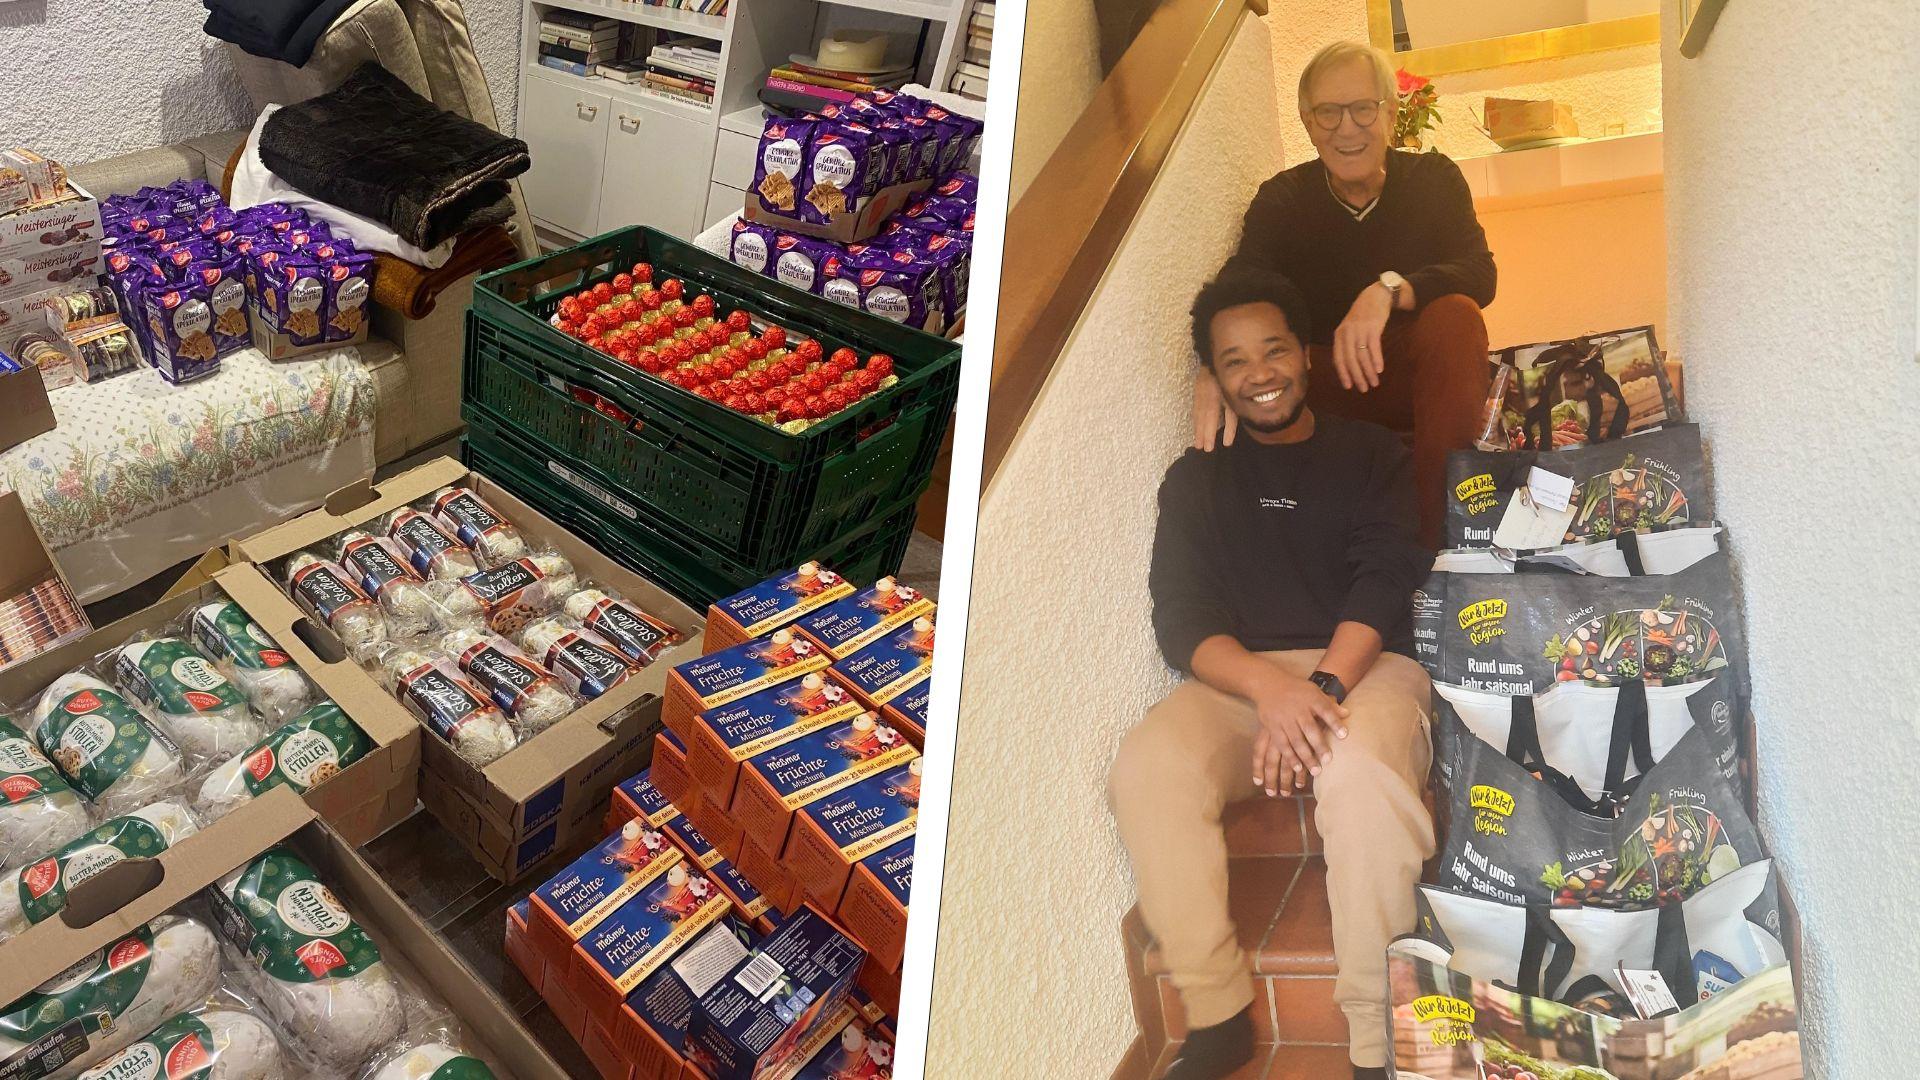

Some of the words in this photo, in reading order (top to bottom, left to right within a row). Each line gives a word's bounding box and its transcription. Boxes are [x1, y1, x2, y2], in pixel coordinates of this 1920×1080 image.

[766, 154, 798, 166] SPEKULATIUS
[816, 162, 852, 176] SPEKULATIUS
[822, 156, 846, 166] GEWÜRZ
[14, 213, 77, 234] Meistersinger
[24, 251, 82, 274] Meistersinger
[736, 247, 765, 261] SPEKULATIUS
[779, 266, 812, 281] SPEKULATIUS
[868, 302, 906, 312] SPEKULATIUS
[1644, 458, 1680, 482] Frühling
[1473, 478, 1479, 490] &
[460, 498, 496, 526] Stollen
[1468, 498, 1498, 516] Region
[414, 520, 450, 548] Stollen
[1464, 527, 1490, 540] Rund
[368, 546, 402, 576] Stollen
[316, 572, 352, 602] Stollen
[484, 571, 528, 597] Stollen
[730, 596, 756, 610] Meßmer
[738, 598, 780, 618] Früchte-
[1684, 597, 1714, 618] Frühling
[752, 608, 780, 622] Mischung
[812, 613, 839, 629] Meßmer
[1460, 611, 1475, 625] Wir
[1476, 605, 1481, 617] &
[1483, 602, 1503, 616] Jetzt
[1566, 606, 1594, 625] Winter
[610, 610, 656, 642] Stollen
[822, 615, 862, 638] Früchte-
[837, 626, 863, 641] Mischung
[1470, 627, 1506, 645] Region
[484, 654, 530, 684] Stollen
[576, 644, 624, 674] Stollen
[849, 656, 876, 673] Meßmer
[1468, 658, 1496, 673] Rund
[1499, 664, 1524, 675] ums
[186, 660, 218, 686] STOLLEN
[690, 662, 722, 677] Meßmer
[698, 666, 746, 687] Früchte-
[859, 659, 900, 683] Früchte-
[875, 670, 902, 686] Mischung
[584, 675, 606, 692] EDEKA
[711, 677, 743, 692] Mischung
[1461, 676, 1484, 690] Jahr
[1485, 679, 1533, 694] saisonal
[428, 676, 472, 712] Stollen
[717, 709, 750, 725] Meßmer
[726, 714, 776, 738] Früchte-
[69, 725, 100, 754] STOLLEN
[740, 726, 774, 741] Mischung
[288, 741, 329, 775] STOLLEN
[735, 749, 745, 757] Für
[746, 744, 760, 752] deine
[767, 753, 800, 771] Meßmer
[776, 758, 828, 784] Früchte-
[792, 771, 826, 789] Mischung
[788, 798, 798, 806] Für
[799, 792, 814, 801] deine
[1485, 789, 1490, 804] &
[1491, 790, 1511, 811] Jetzt
[1669, 787, 1706, 805] Frühling
[822, 801, 857, 820] Meßmer
[832, 806, 885, 835] Früchte-
[848, 820, 885, 839] Mischung
[1475, 816, 1507, 836] Region
[846, 849, 857, 858] Für
[857, 842, 873, 853] deine
[1567, 848, 1605, 862] Winter
[68, 854, 119, 883] BUTTER-MANDEL-
[1464, 840, 1489, 872] Rund
[1489, 864, 1515, 887] ums
[551, 875, 580, 899] Meßmer
[1451, 856, 1471, 882] Jahr
[1472, 876, 1526, 905] saisonal
[561, 876, 605, 912] Früchte-
[573, 926, 583, 934] Für
[584, 915, 597, 926] deine
[633, 873, 647, 886] Beutel
[660, 851, 678, 866] Genuss
[295, 888, 339, 929] STOLLEN
[576, 891, 605, 915] Mischung
[596, 925, 626, 950] Meßmer
[606, 926, 651, 964] Früchte-
[620, 978, 631, 988] Für
[630, 966, 644, 978] deine
[642, 942, 674, 966] Teemomente:
[680, 923, 697, 938] Beutel
[708, 899, 726, 913] Genuss
[622, 942, 651, 967] Mischung
[1414, 1000, 1435, 1018] Wir
[1437, 998, 1446, 1014] &
[1445, 1000, 1471, 1019] Jetzt
[1431, 1030, 1477, 1047] Region
[795, 1050, 804, 1060] 25
[802, 1040, 818, 1054] Beutel
